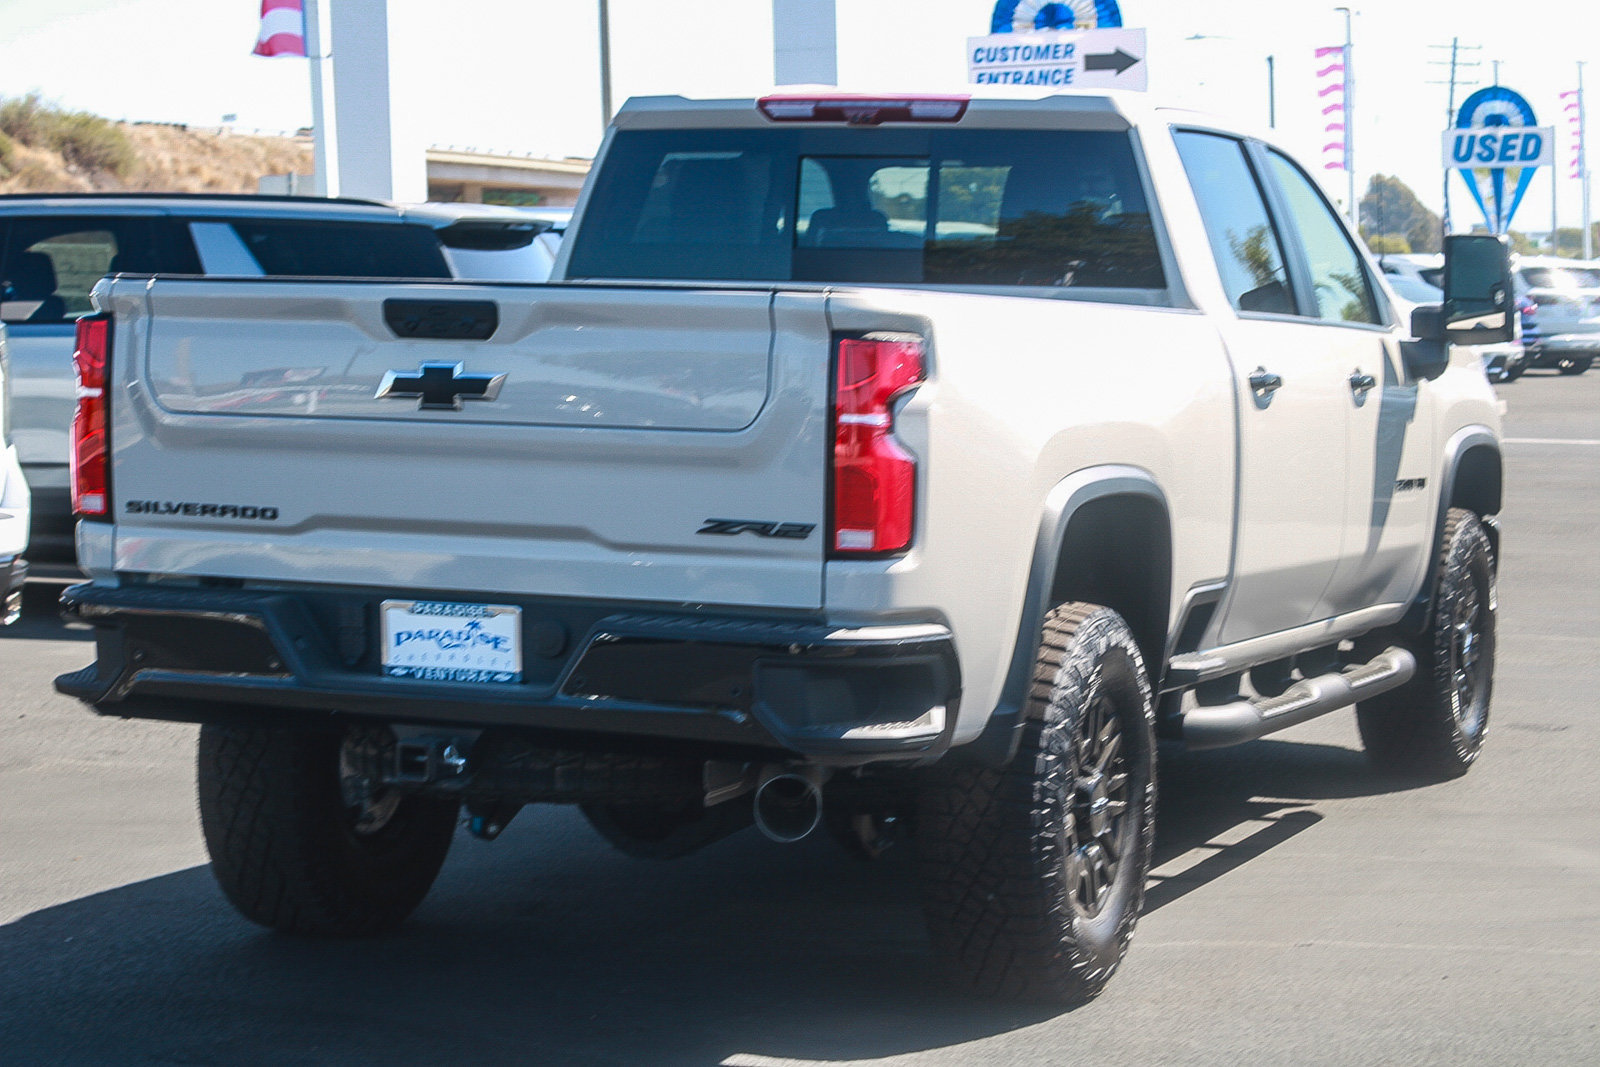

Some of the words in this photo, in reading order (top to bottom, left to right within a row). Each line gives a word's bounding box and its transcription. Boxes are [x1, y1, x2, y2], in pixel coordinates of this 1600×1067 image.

[973, 43, 1075, 64] CUSTOMER
[976, 68, 1075, 86] ENTRANCE
[1453, 133, 1542, 163] USED
[125, 500, 280, 520] SILVERADO
[695, 517, 818, 540] ZR2
